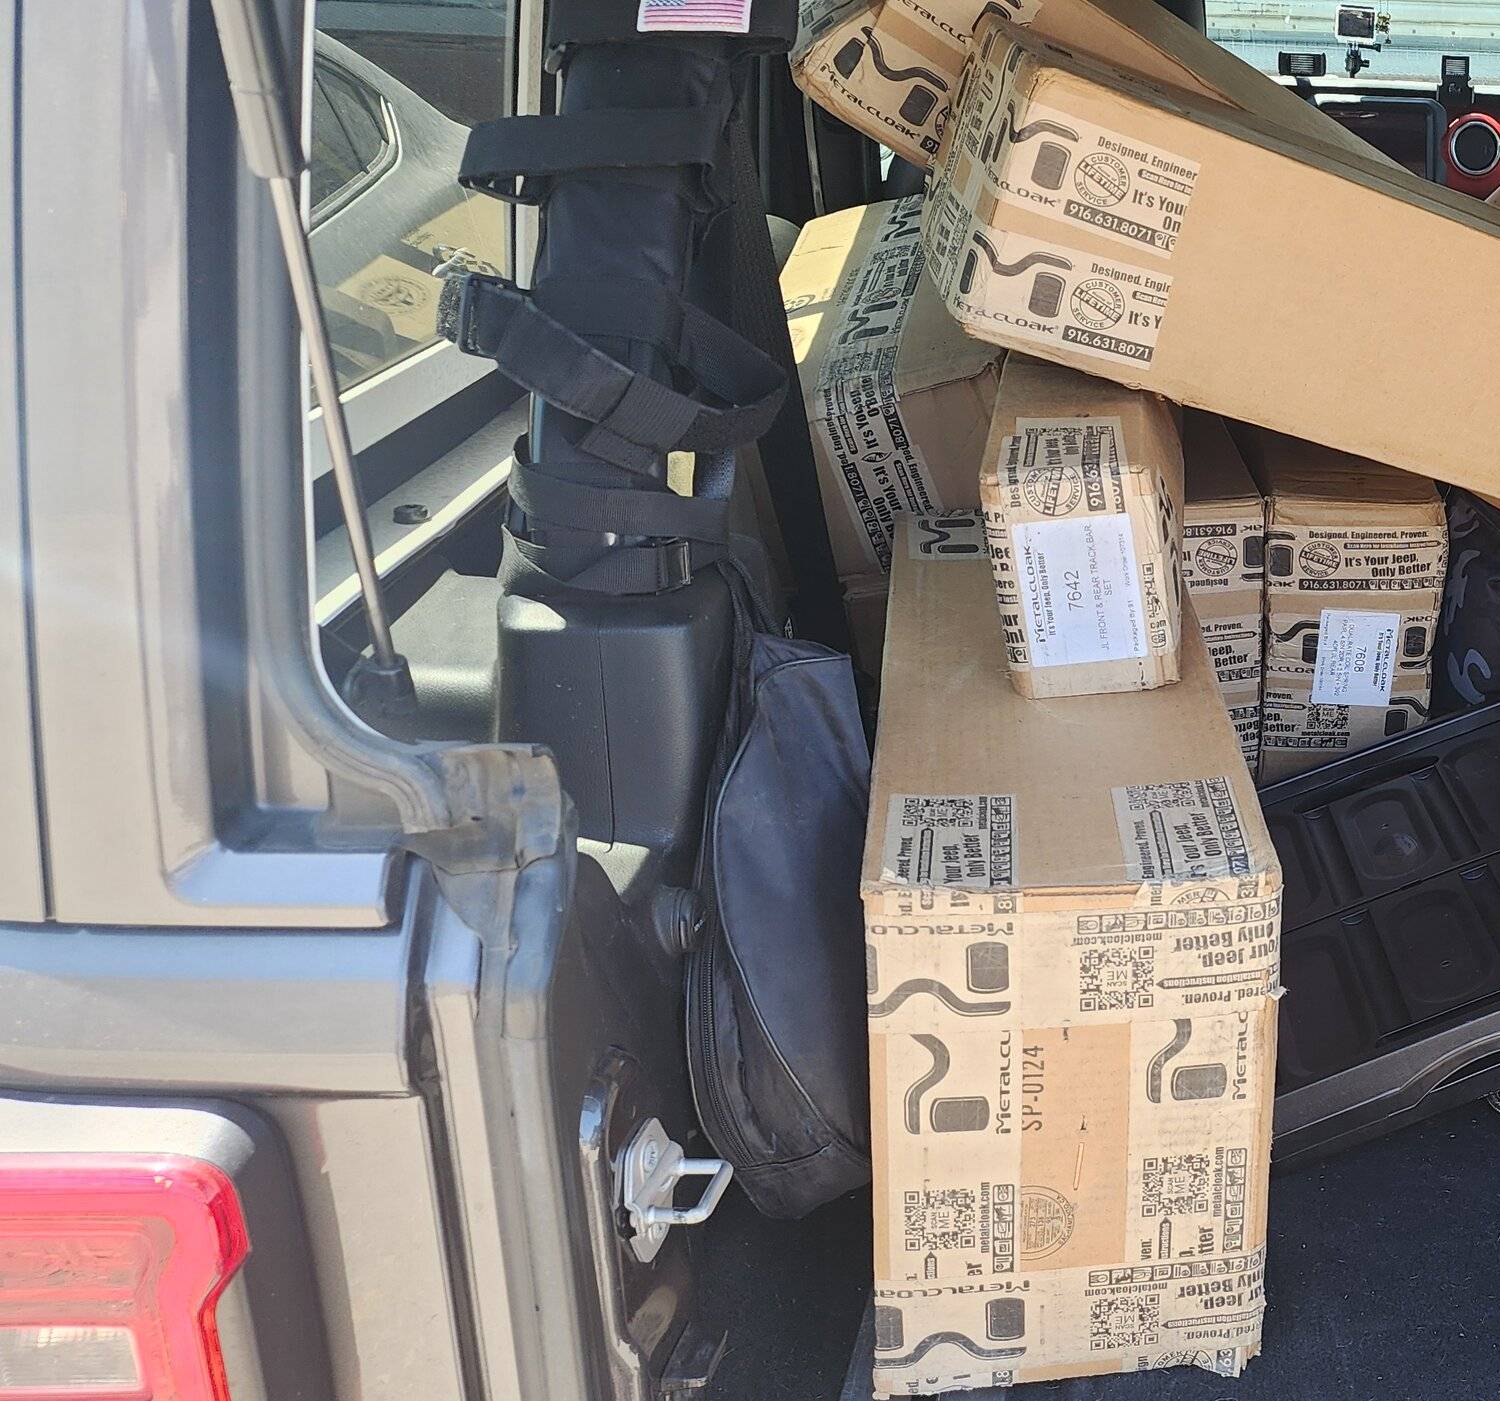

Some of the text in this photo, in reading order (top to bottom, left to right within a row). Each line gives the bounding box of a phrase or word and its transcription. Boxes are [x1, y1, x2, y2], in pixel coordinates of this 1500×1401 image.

[1098, 136, 1149, 165] Designed.
[1132, 188, 1188, 216] It's You
[1069, 203, 1153, 242] 916.631.8071
[1091, 263, 1142, 286] Designed.
[1128, 310, 1150, 328] It's
[1066, 328, 1151, 360] 916.631.8071
[1308, 530, 1350, 539] Designed.
[1351, 530, 1399, 540] Engineered.
[1345, 553, 1419, 568] It's Your Jeep,
[1371, 563, 1432, 578] Only Better
[1064, 570, 1084, 611] 7642
[1302, 579, 1368, 590] 916.631.8071
[1353, 646, 1367, 673] 7608
[1189, 811, 1213, 838] Better
[962, 833, 983, 859] Better
[1072, 932, 1163, 946] metalcloak.com
[1175, 931, 1234, 953] Better
[1197, 949, 1246, 969] Jeep,
[1106, 970, 1129, 981] ME
[1181, 990, 1231, 1004] Proven.
[1174, 1176, 1185, 1194] ME
[1212, 1147, 1225, 1218] metalcloak.com
[939, 1211, 950, 1230] ME
[979, 1182, 991, 1254] metalcloak.com
[1178, 1278, 1233, 1299] Better
[1199, 1295, 1243, 1310] Jeep,
[1115, 1315, 1136, 1325] ME
[1185, 1328, 1231, 1340] Proven.
